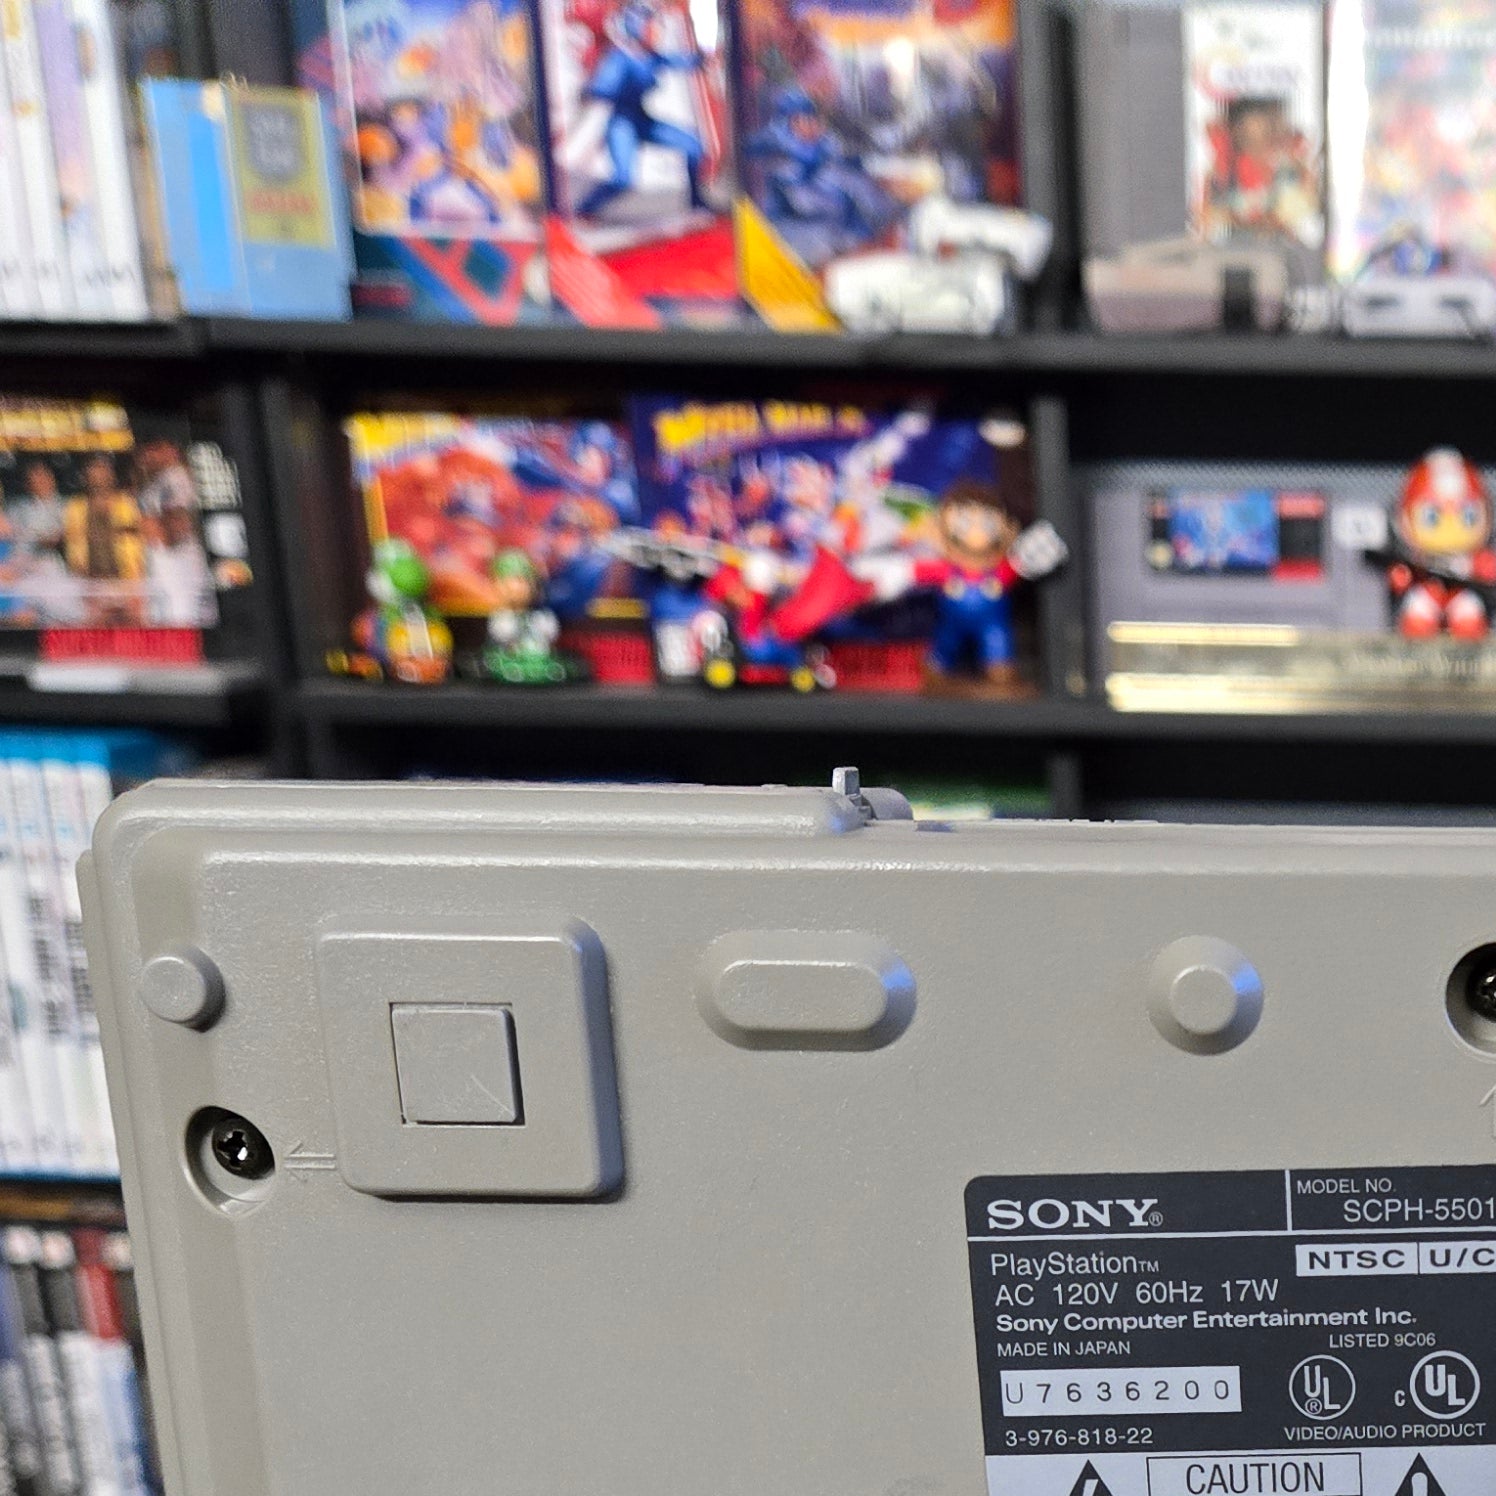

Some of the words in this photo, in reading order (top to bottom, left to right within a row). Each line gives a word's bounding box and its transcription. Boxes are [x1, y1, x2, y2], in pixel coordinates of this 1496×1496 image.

[1297, 1178, 1360, 1194] MODEL
[1366, 1178, 1395, 1193] NO.
[1344, 1196, 1494, 1223] SCPH-5501
[1309, 1249, 1404, 1270] NTSC
[1430, 1247, 1495, 1268] U/C
[995, 1283, 1034, 1307] AC
[1053, 1282, 1118, 1305] 120V
[1136, 1280, 1203, 1304] 60Hz
[1222, 1278, 1278, 1302] 17W
[997, 1314, 1058, 1335] Sony
[1064, 1312, 1187, 1333] Computer
[1193, 1308, 1368, 1329] Entertainment
[1376, 1307, 1416, 1325] Inc.
[997, 1342, 1048, 1357] MADE
[1053, 1342, 1070, 1356] IN
[1075, 1340, 1130, 1355] JAPAN
[1330, 1333, 1389, 1349] LISTED
[1394, 1332, 1436, 1347] 9C06
[1006, 1427, 1153, 1447] 3-976-818-22
[1284, 1425, 1397, 1441] VIDEO/AUDIO
[1402, 1423, 1486, 1438] PRODUCT
[1186, 1461, 1324, 1495] CAUTION
